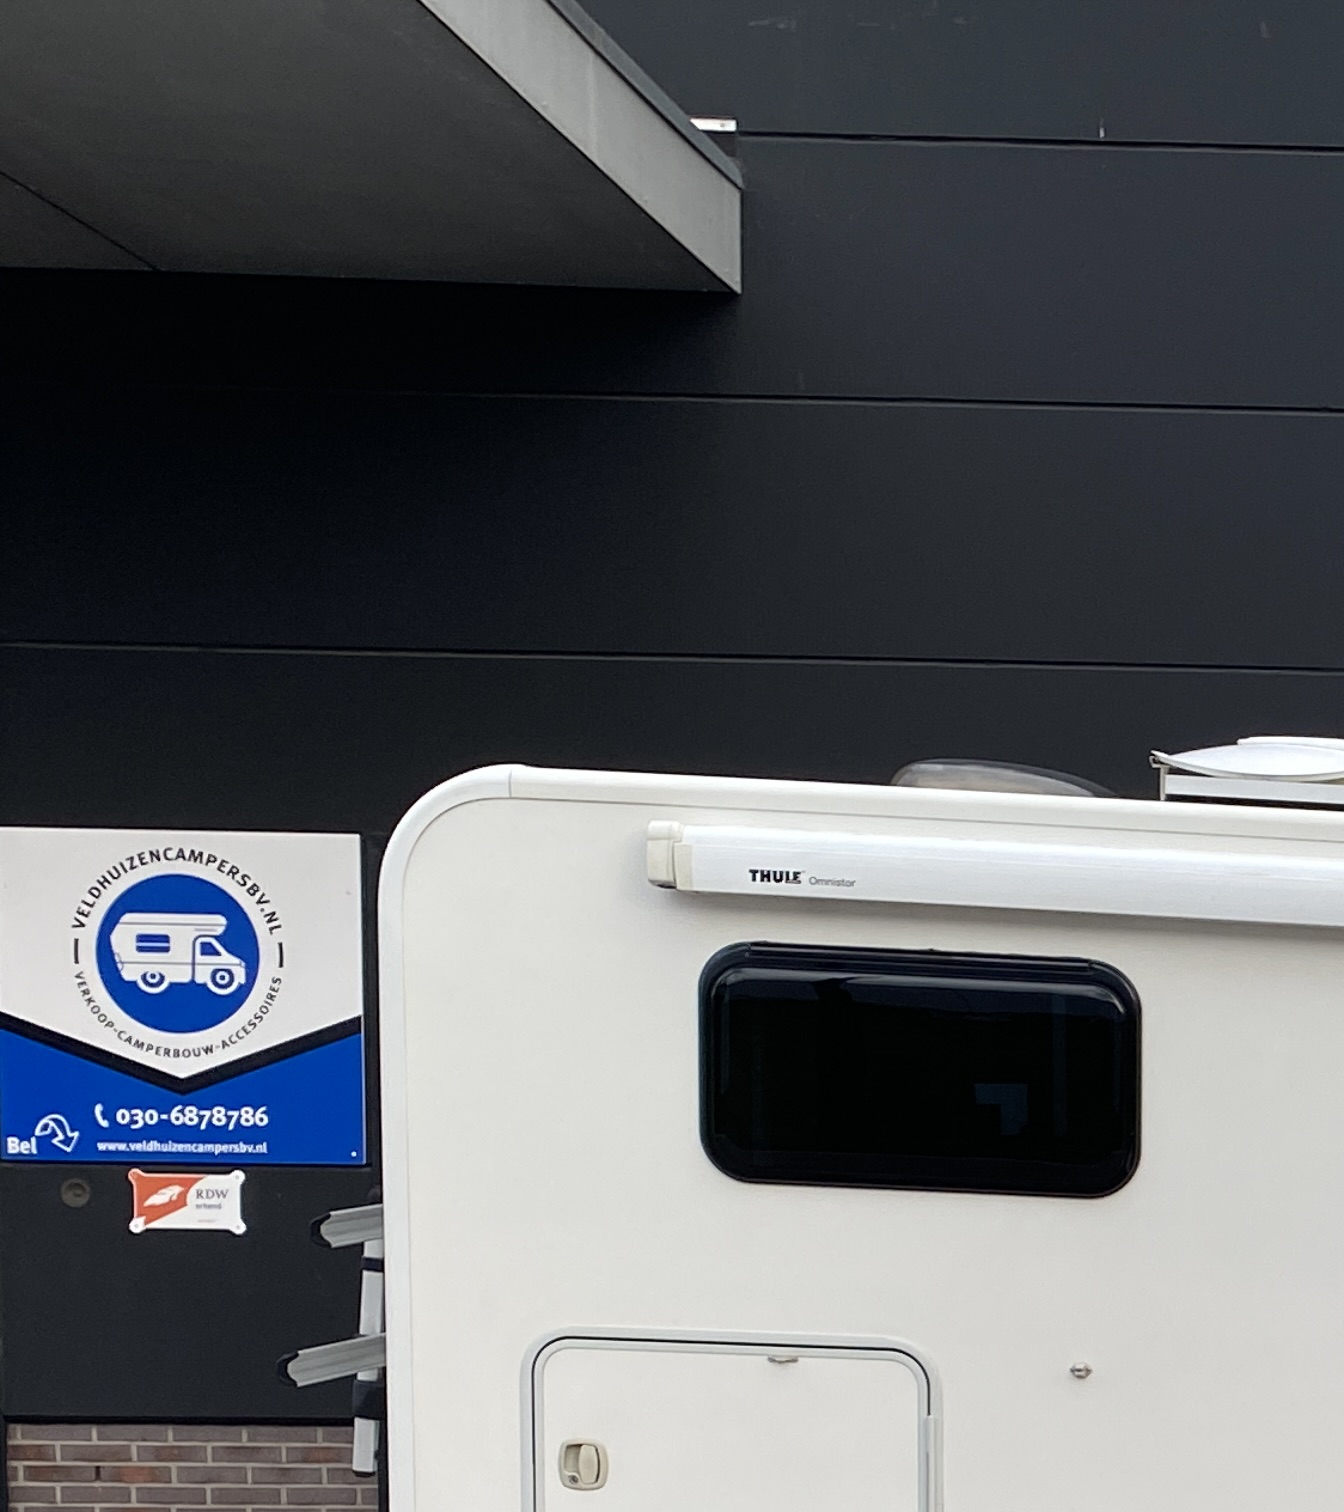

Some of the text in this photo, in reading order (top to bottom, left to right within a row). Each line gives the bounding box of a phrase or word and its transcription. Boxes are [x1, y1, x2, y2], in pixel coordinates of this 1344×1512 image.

[748, 868, 857, 888] THULE Omnistor
[71, 847, 284, 936] VELDHUIZENCAMPERSBV.NL
[74, 971, 282, 1059] VERKOOP-CAMPERBOUW-ACCESSOIRES
[115, 1104, 270, 1131] 030-6878786
[6, 1135, 38, 1155] Bel
[97, 1140, 268, 1156] www.veldhuizencampersbv.nl
[195, 1188, 230, 1200] RDW
